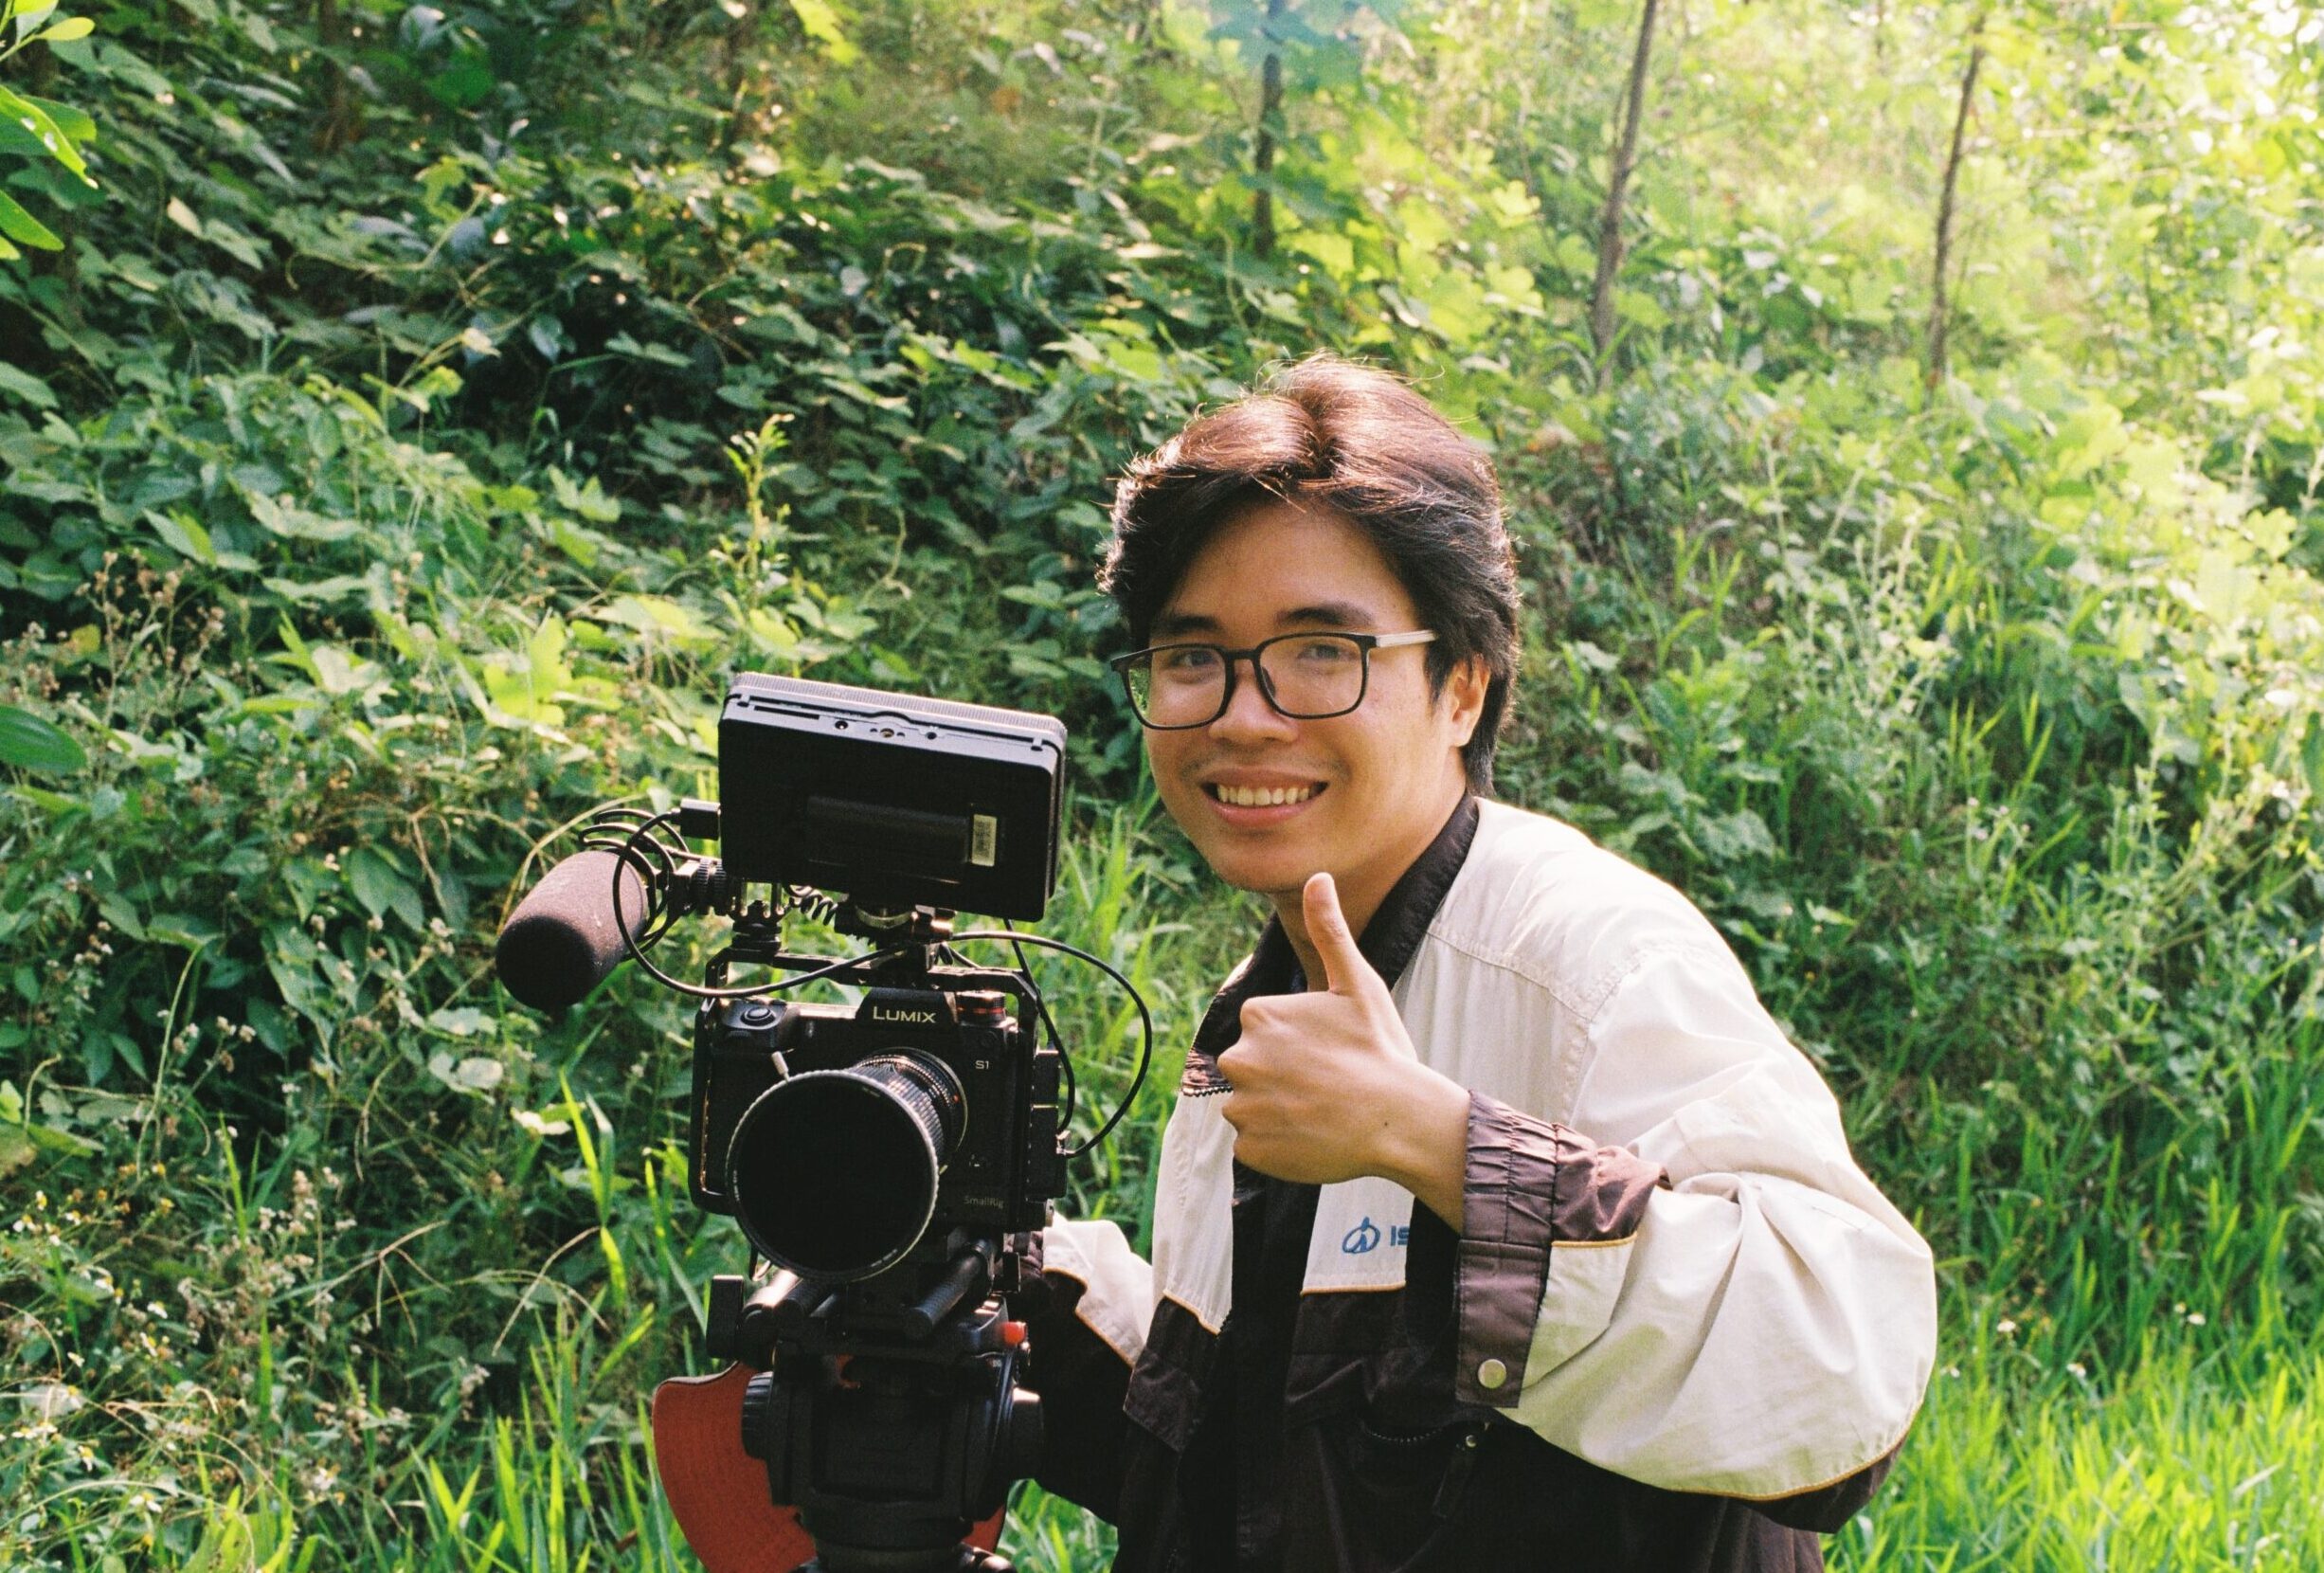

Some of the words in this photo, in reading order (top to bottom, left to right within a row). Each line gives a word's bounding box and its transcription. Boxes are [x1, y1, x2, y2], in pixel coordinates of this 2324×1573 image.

[873, 1005, 937, 1023] LUMIX
[975, 1059, 990, 1070] S1
[963, 1195, 1004, 1209] SmallRig
